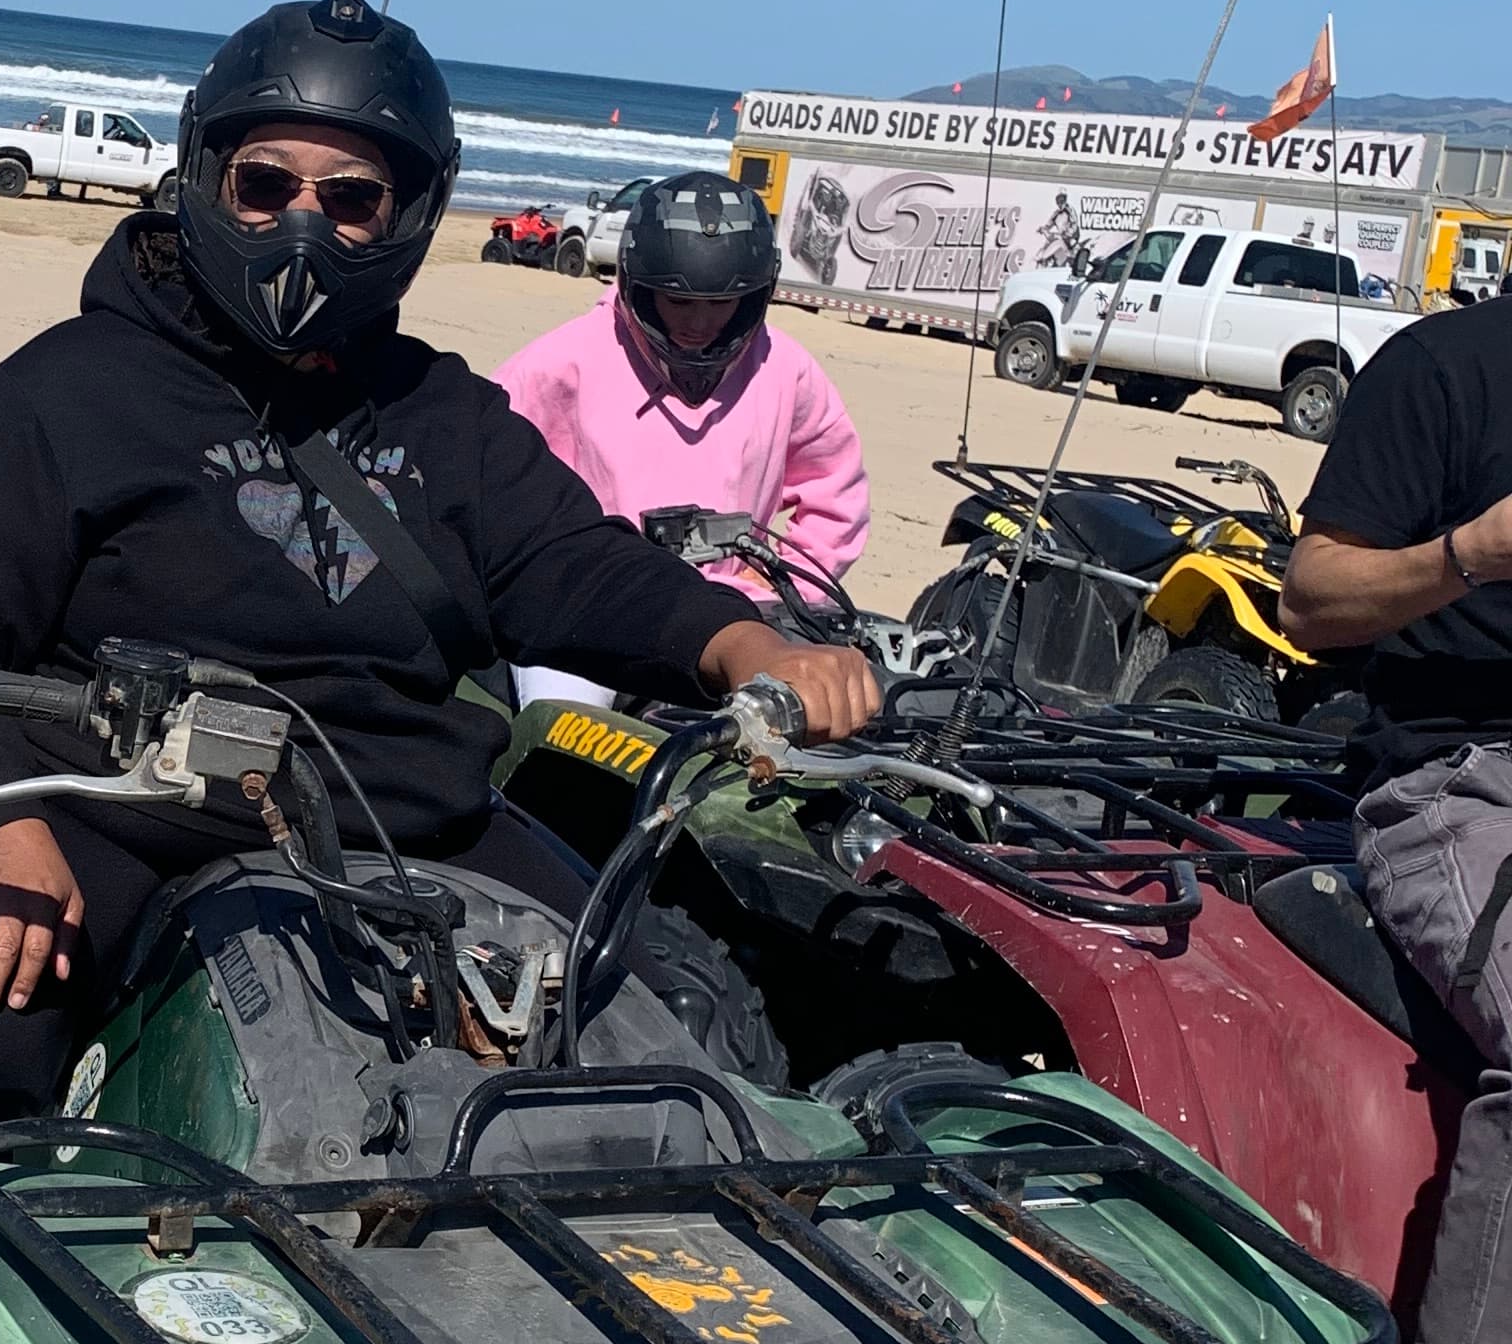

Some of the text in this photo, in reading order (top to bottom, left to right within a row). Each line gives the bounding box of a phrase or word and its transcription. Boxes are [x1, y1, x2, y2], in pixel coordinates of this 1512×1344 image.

[748, 100, 1414, 179] QUADS AND SIDE BY SIDES RENTALS STEVE'S ATV
[1080, 196, 1146, 215] WALK-UPS
[866, 248, 920, 292] ATV
[545, 711, 657, 774] ABBOTT
[216, 935, 270, 1022] YAMAHA
[199, 1319, 272, 1337] 033
